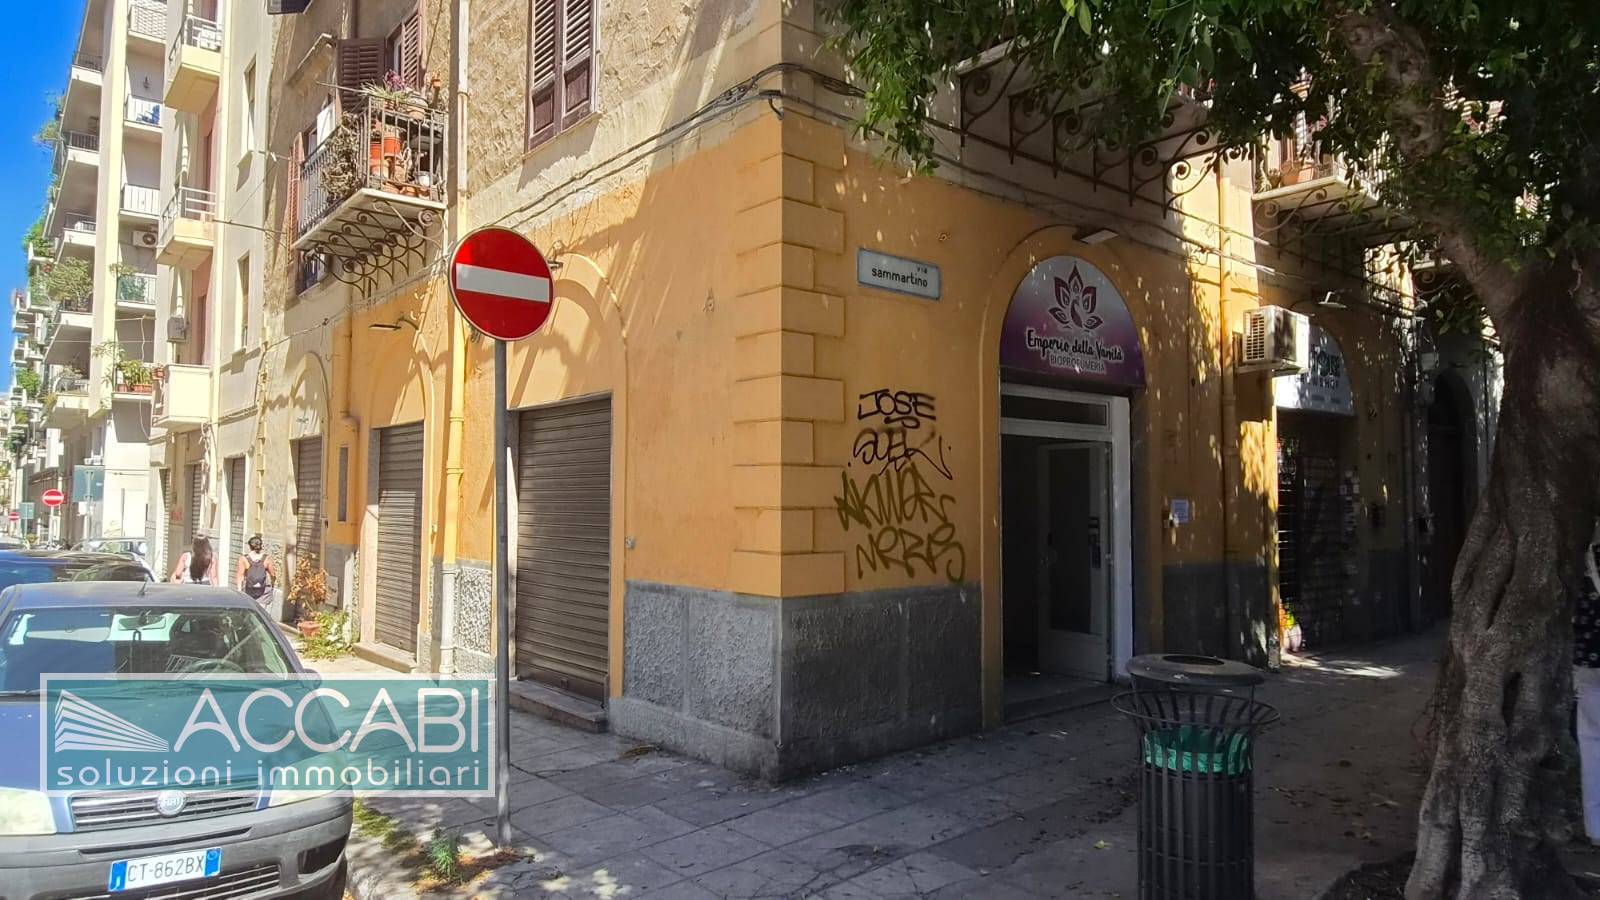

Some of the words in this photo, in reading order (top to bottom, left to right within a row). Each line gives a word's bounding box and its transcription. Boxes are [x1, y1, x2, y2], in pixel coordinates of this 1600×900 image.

[871, 267, 928, 288] sammartino
[1027, 329, 1069, 358] Emporio
[1072, 339, 1094, 356] della
[1050, 354, 1105, 372] BIOPROFUMERIA
[858, 388, 937, 421] JOSE
